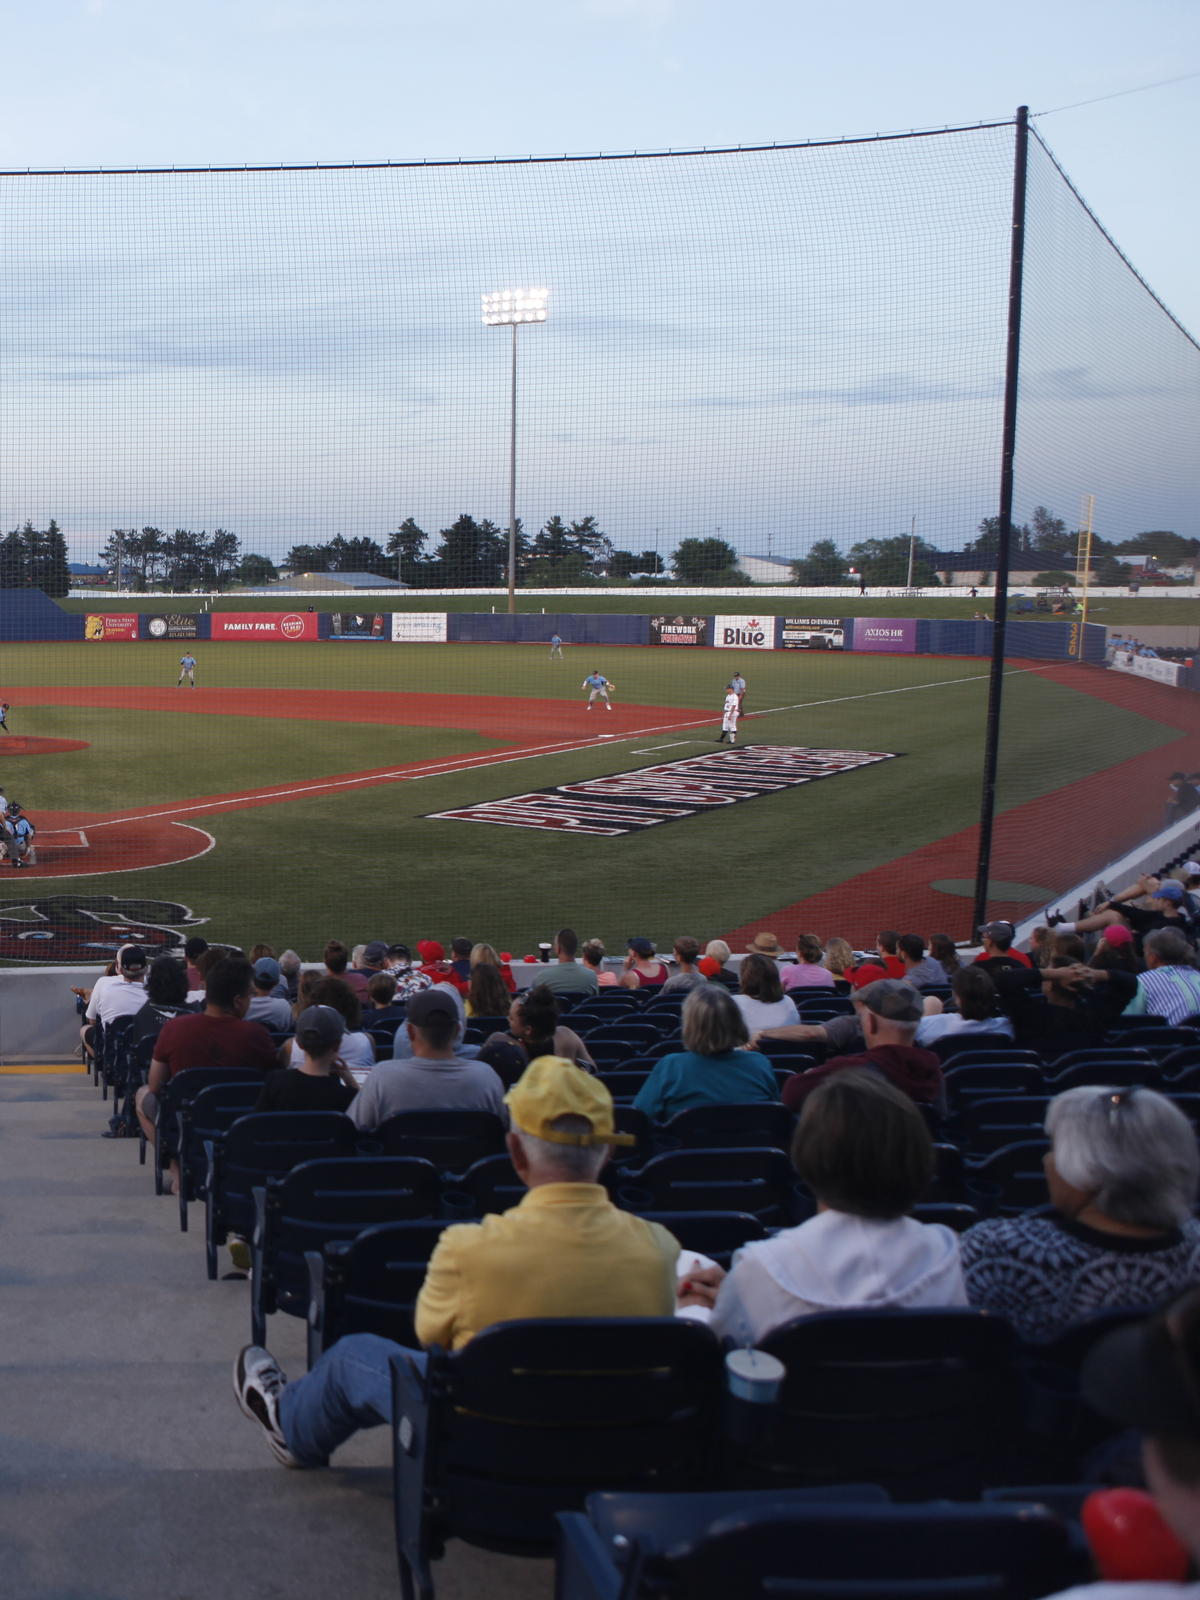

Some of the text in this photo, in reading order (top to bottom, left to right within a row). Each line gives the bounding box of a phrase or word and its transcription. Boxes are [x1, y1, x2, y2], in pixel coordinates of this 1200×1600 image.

[661, 625, 697, 634] FIREWORK
[865, 628, 904, 637] AXIOS HR
[724, 628, 765, 646] Blue
[425, 744, 896, 836] PIT SPITTERS
